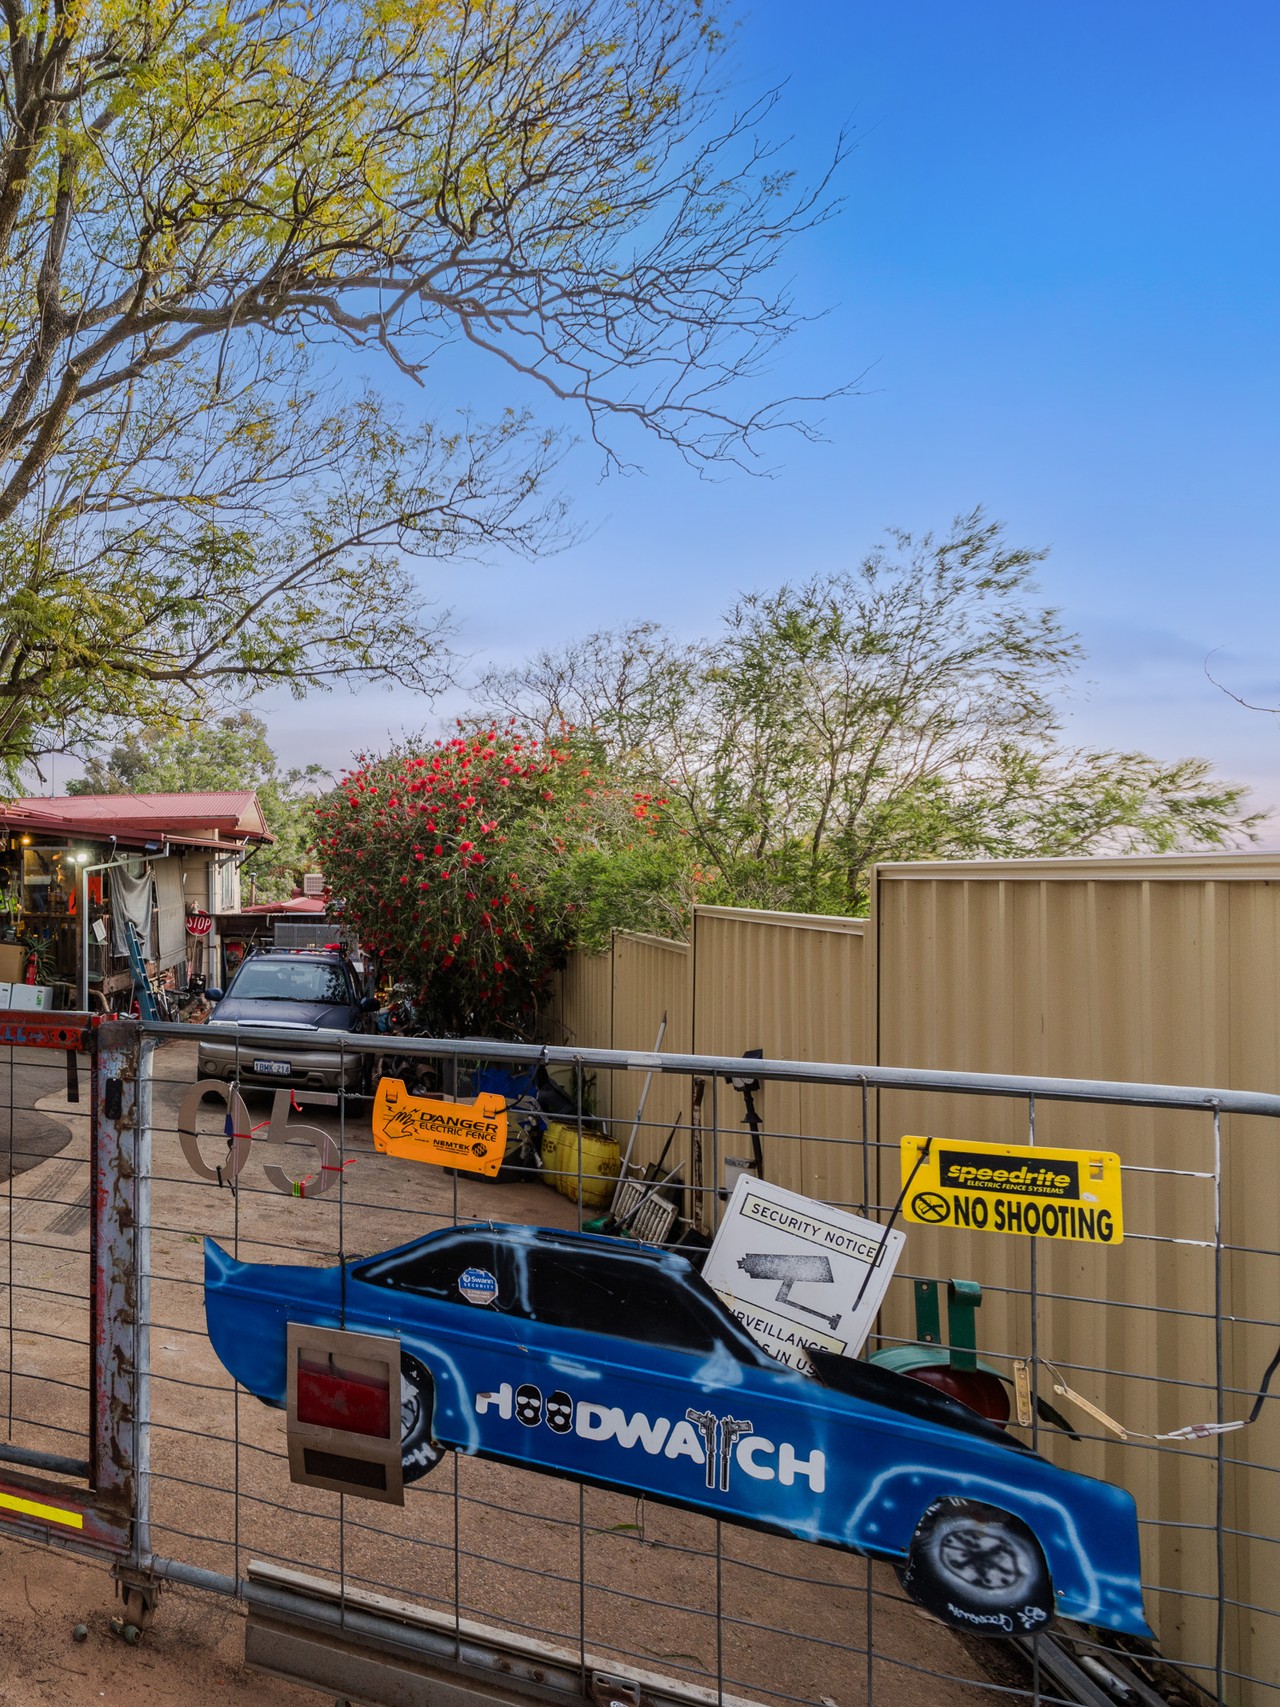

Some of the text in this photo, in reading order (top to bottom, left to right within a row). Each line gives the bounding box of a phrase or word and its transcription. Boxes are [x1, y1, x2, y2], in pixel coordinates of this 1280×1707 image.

[187, 915, 211, 930] STOP
[419, 1122, 497, 1143] ELECTRIC FENCE
[420, 1112, 498, 1133] DANGER
[433, 1139, 470, 1151] NEMTEK
[947, 1164, 1071, 1187] speedrite
[967, 1180, 1064, 1194] ELECTRIC FENCE SYSTEMS
[953, 1195, 1113, 1242] NO SHOOTING
[751, 1203, 877, 1259] SECURITY NOTICE
[471, 1276, 494, 1284] Swann
[774, 1349, 817, 1375] IN US
